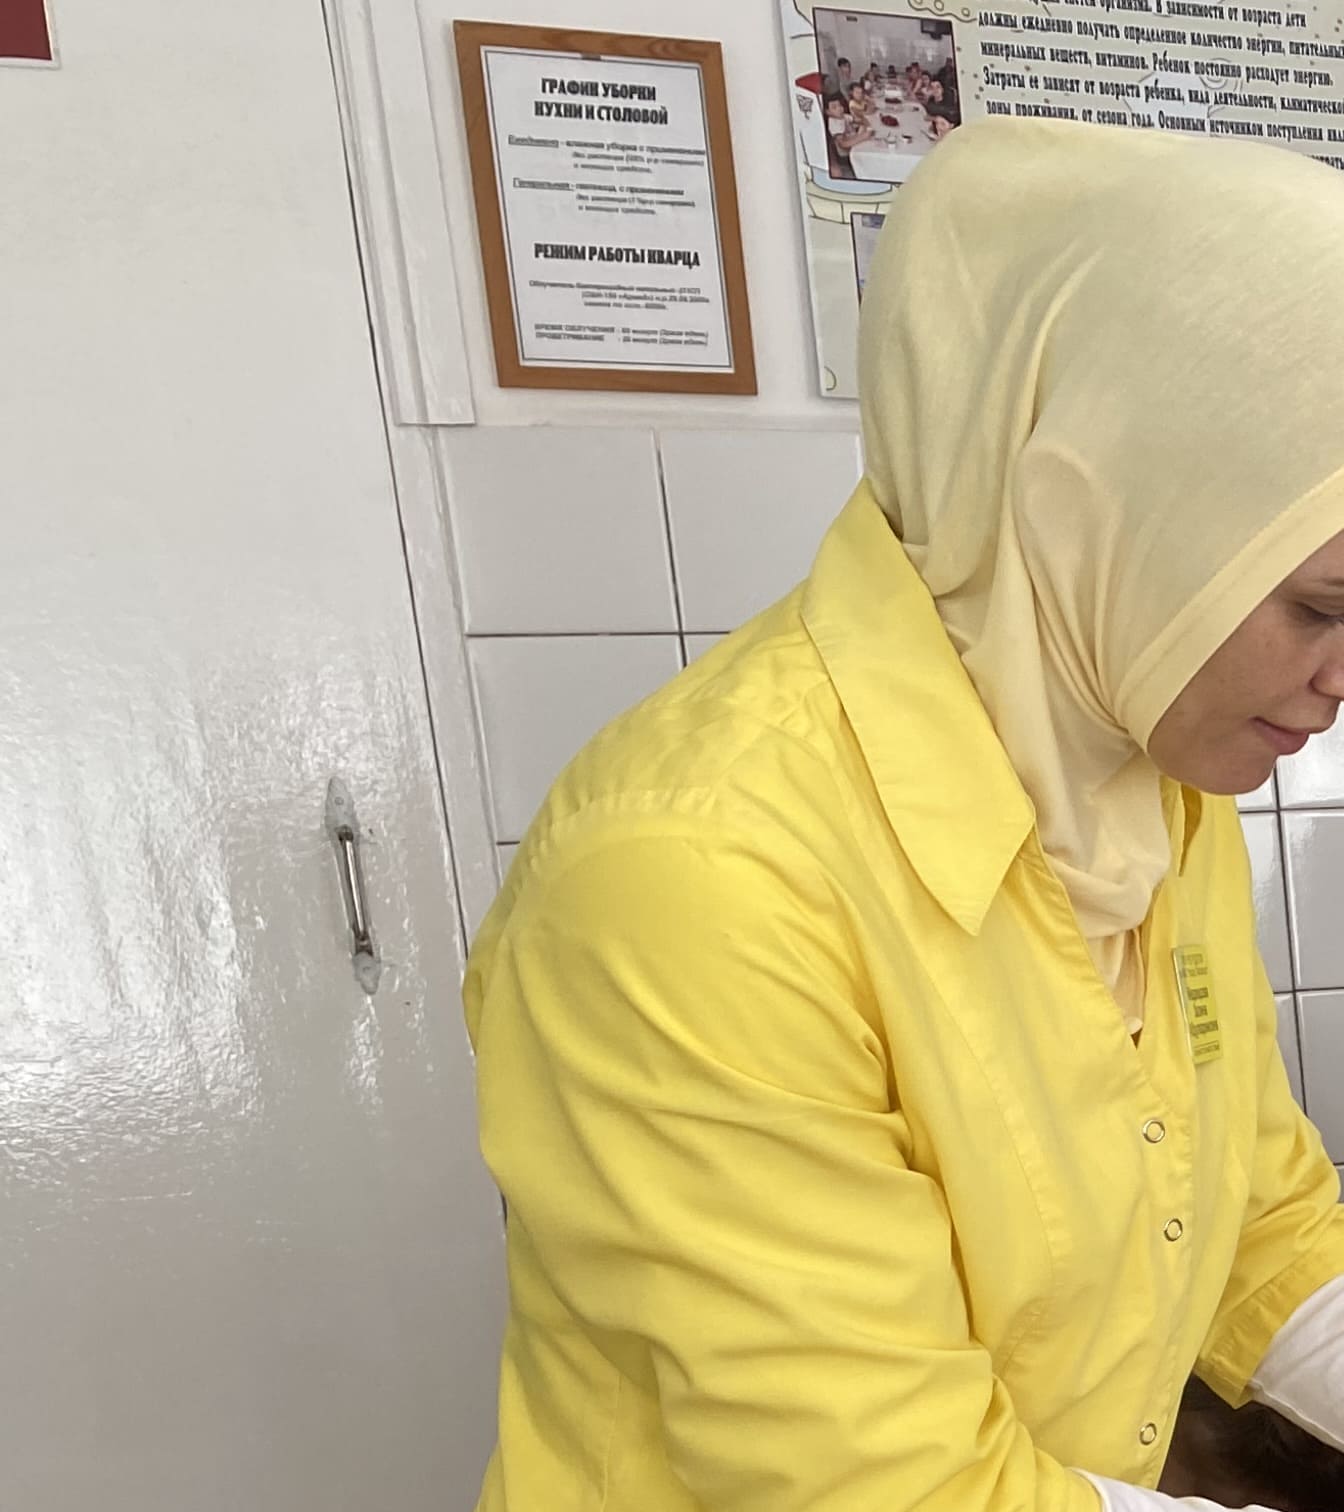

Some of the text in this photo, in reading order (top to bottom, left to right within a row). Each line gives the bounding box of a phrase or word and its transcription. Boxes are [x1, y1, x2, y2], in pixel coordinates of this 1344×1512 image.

[978, 12, 1017, 29] должны
[1022, 15, 1072, 34] ежедневно
[1076, 21, 1120, 40] получать
[1124, 26, 1186, 45] определенное
[1190, 30, 1243, 50] количество
[1167, 2, 1224, 20] зависимости
[1228, 7, 1239, 17] от
[1242, 8, 1282, 27] возраста
[1285, 13, 1306, 28] дети
[980, 41, 1333, 88] минеральных веществ, витаминов. Ребенок постоянно расходует энергию.
[541, 78, 656, 101] ГРАФИК УБОРКИ
[983, 66, 1025, 90] Затраты
[1029, 75, 1039, 87] ее
[1042, 76, 1080, 93] зависят
[1084, 79, 1095, 94] от
[1099, 81, 1141, 100] возраста
[1145, 78, 1185, 105] ребенка,
[1188, 89, 1210, 104] вида
[1213, 93, 1277, 112] деятельности,
[534, 101, 668, 125] КУХНИ И СТОЛОВОЙ
[986, 100, 1011, 115] зоны
[1082, 109, 1093, 122] от
[1097, 110, 1128, 126] сезона
[1158, 110, 1206, 132] Основным
[1209, 118, 1264, 137] источником
[1266, 124, 1323, 143] поступления
[534, 243, 700, 269] РЕЖИМ РАБОТЫ КВАРЦА
